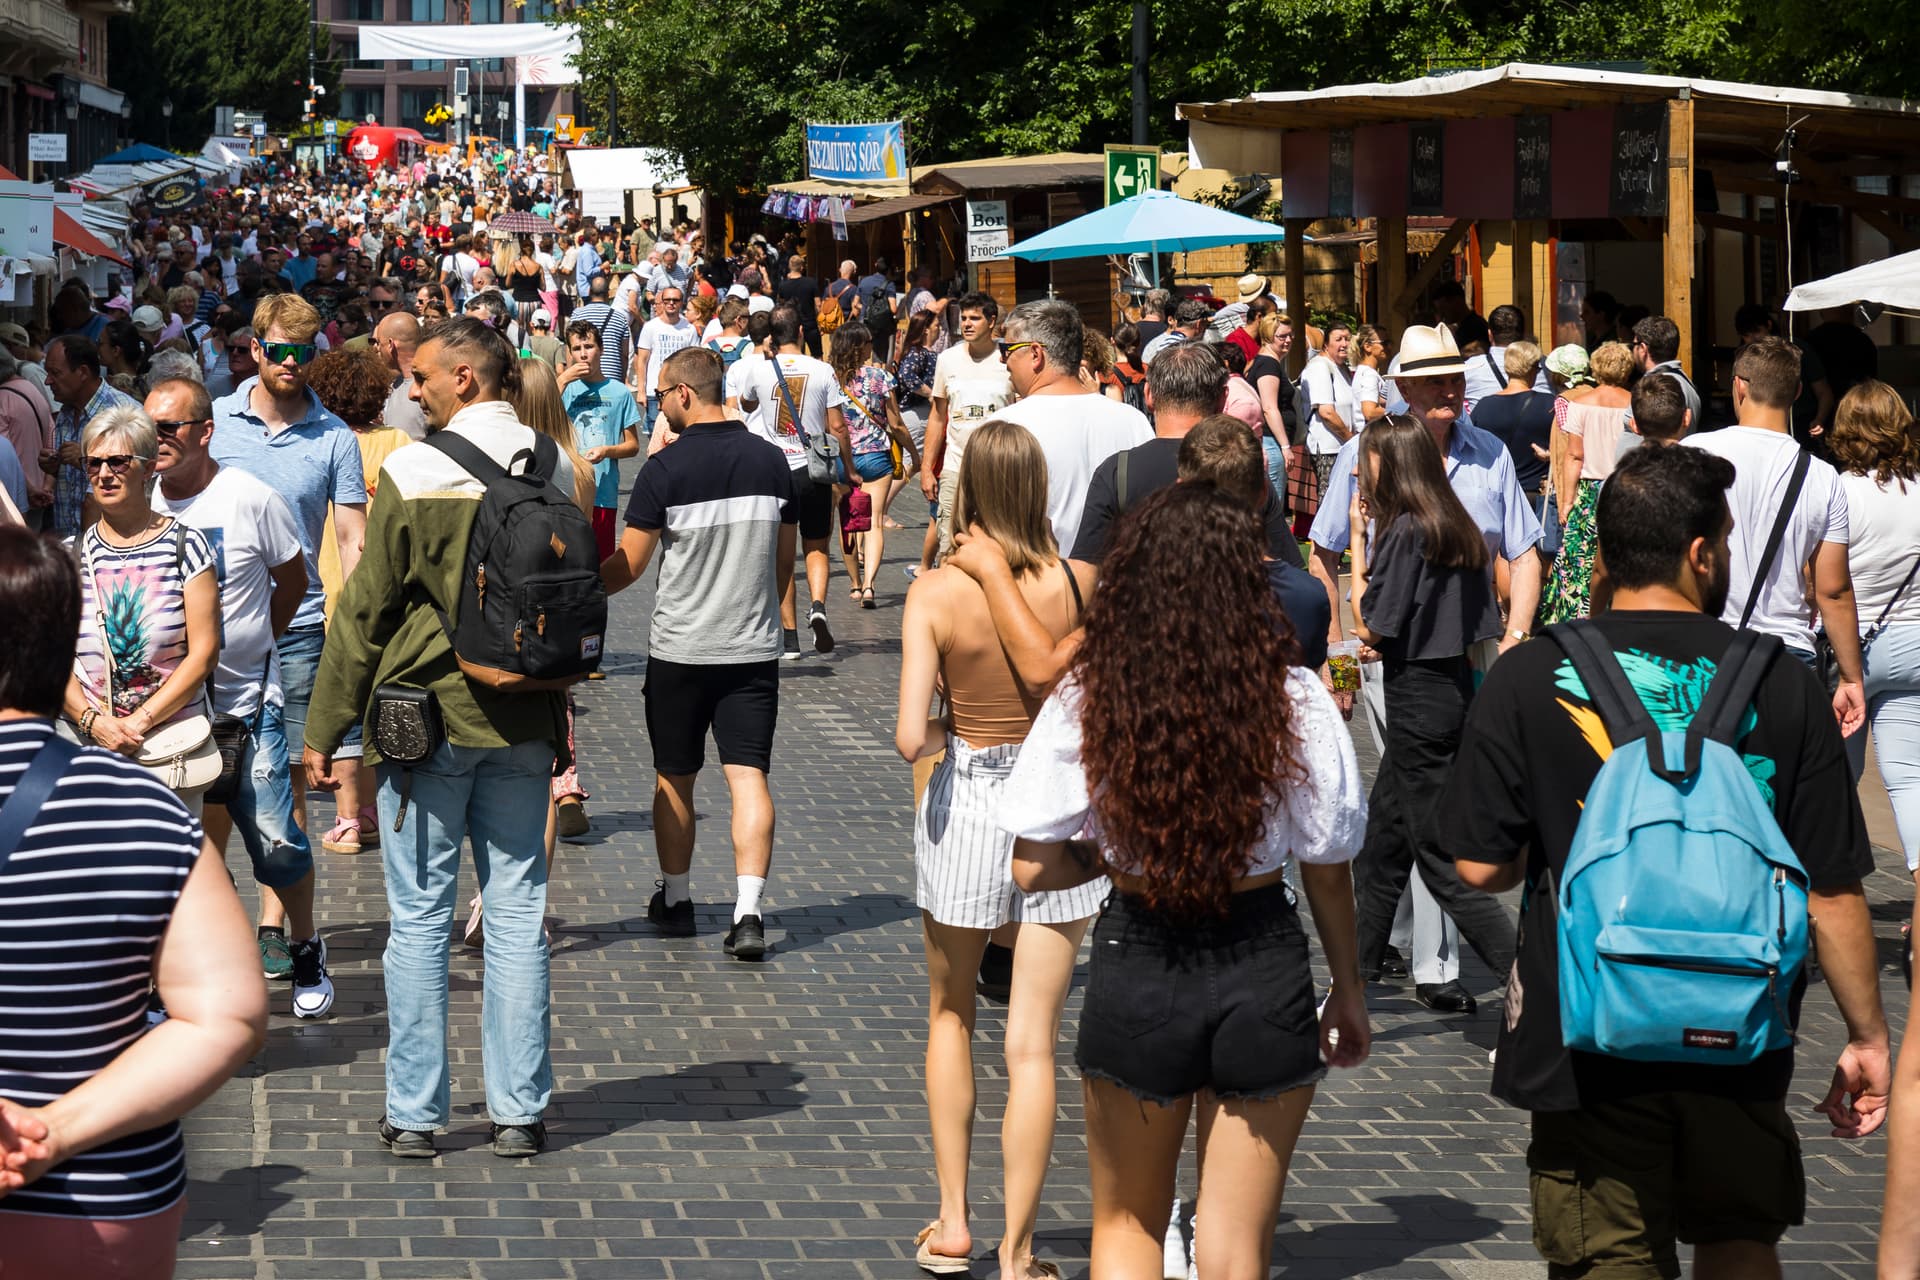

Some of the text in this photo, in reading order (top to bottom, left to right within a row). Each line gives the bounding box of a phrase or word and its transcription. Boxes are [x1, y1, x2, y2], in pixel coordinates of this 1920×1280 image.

[859, 132, 881, 172] SÖR
[971, 213, 1004, 227] Bor
[584, 643, 599, 653] FILA
[1690, 1035, 1729, 1044] EASTPAK
